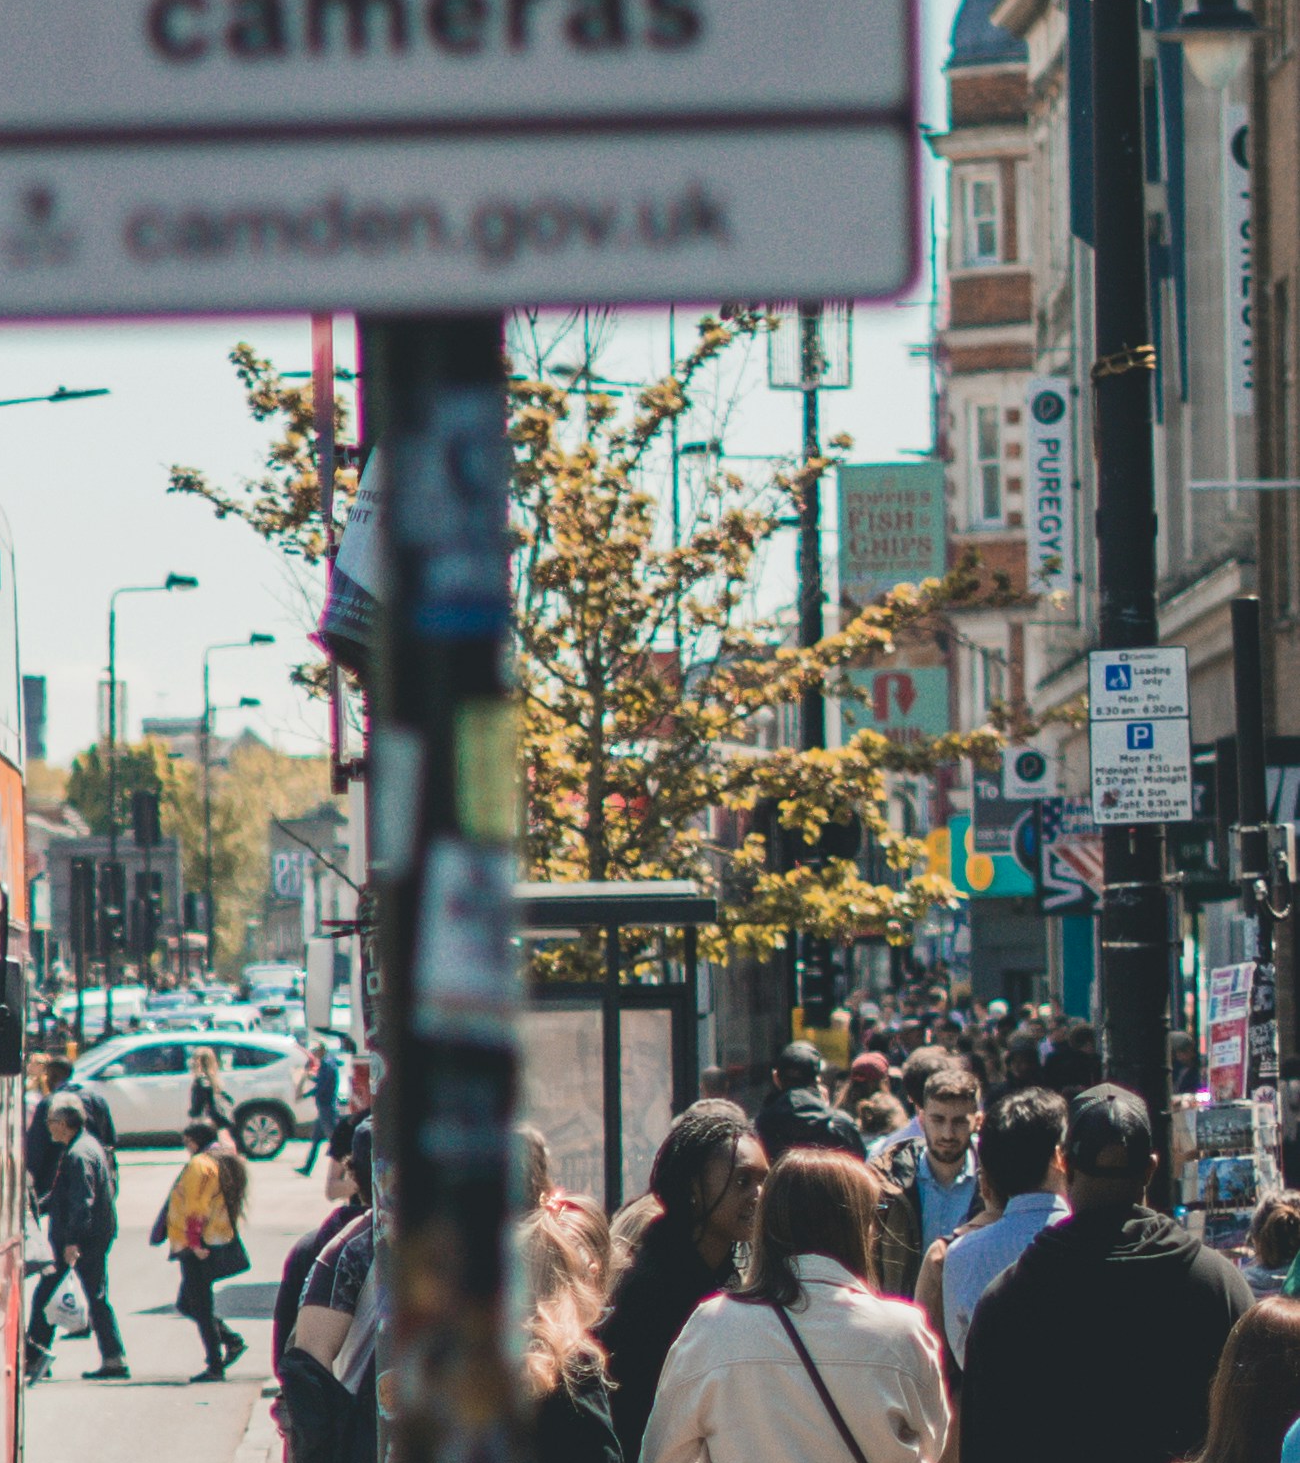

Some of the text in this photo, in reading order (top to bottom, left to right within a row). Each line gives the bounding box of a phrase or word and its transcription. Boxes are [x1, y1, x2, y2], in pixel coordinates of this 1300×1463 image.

[122, 185, 733, 267] camden.gov.uk
[1134, 666, 1171, 676] Loading
[1142, 678, 1163, 686] only
[1118, 695, 1139, 703] Mon
[1168, 705, 1183, 714] pm
[1133, 726, 1149, 747] P
[1119, 755, 1140, 763] Mon
[1095, 766, 1138, 776] Midnight
[1121, 777, 1136, 786] pm
[1143, 775, 1188, 785] Midnight
[977, 781, 999, 800] To
[1148, 788, 1167, 796] Sun
[1113, 811, 1128, 820] pm
[1136, 808, 1180, 819] Midnight
